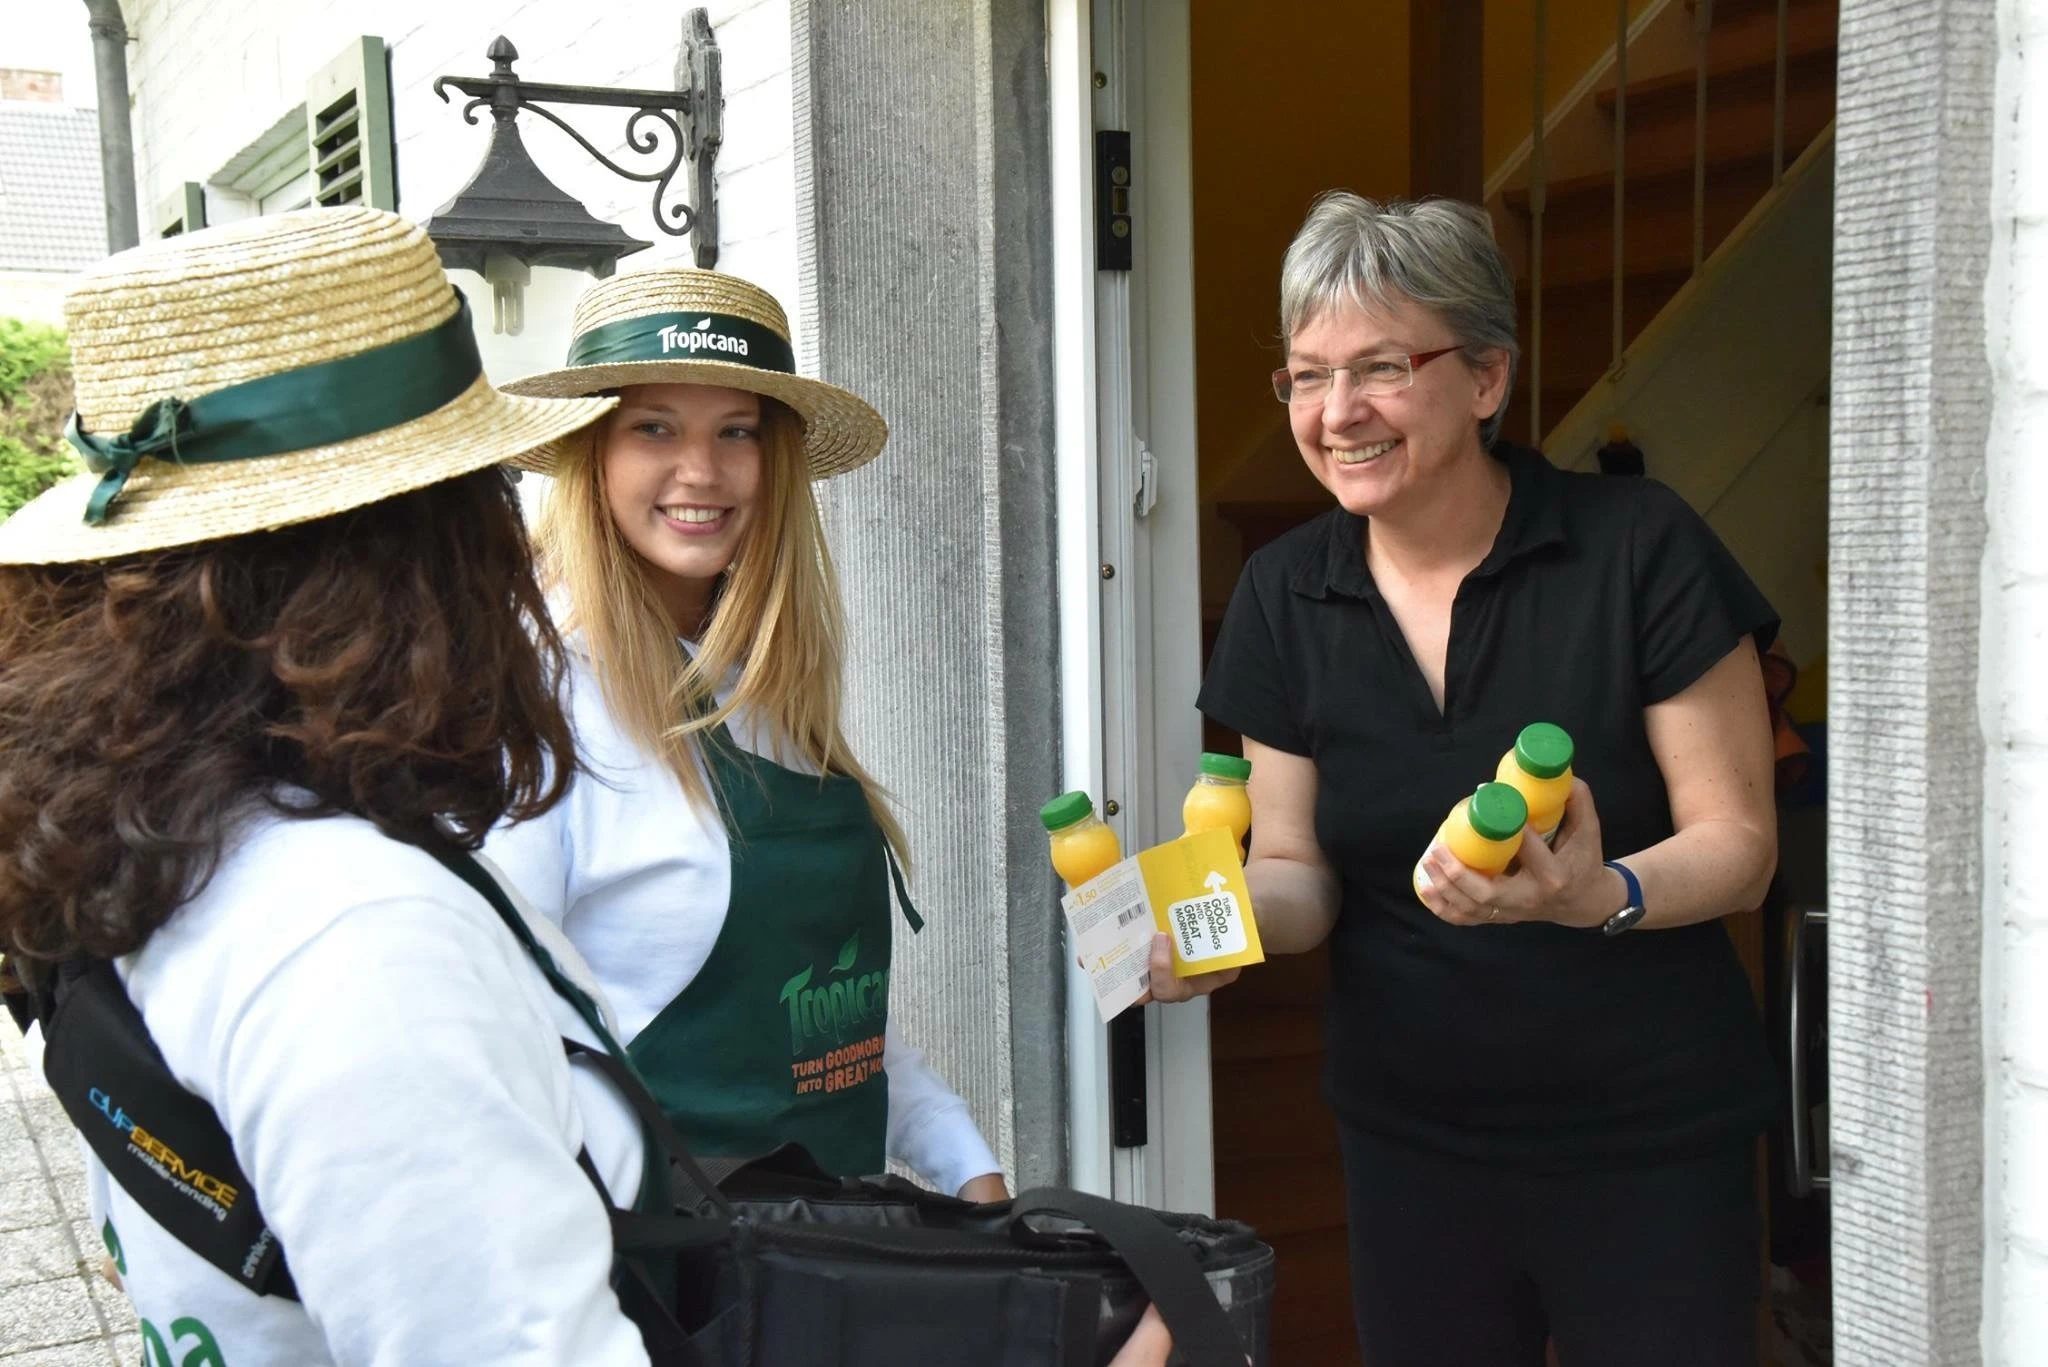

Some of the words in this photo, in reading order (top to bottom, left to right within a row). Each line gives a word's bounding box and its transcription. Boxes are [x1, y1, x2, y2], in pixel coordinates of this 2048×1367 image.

[656, 324, 748, 356] Tropicana
[1184, 904, 1201, 939] GREAT
[1194, 903, 1204, 920] INTO
[1211, 898, 1228, 934] GOOD
[1222, 897, 1232, 917] TURN
[1175, 908, 1194, 956] MORNINGS
[1202, 901, 1221, 950] MORNINGS
[792, 1058, 823, 1078] TURN
[797, 1079, 822, 1094] INTO
[825, 1063, 867, 1092] GREAT
